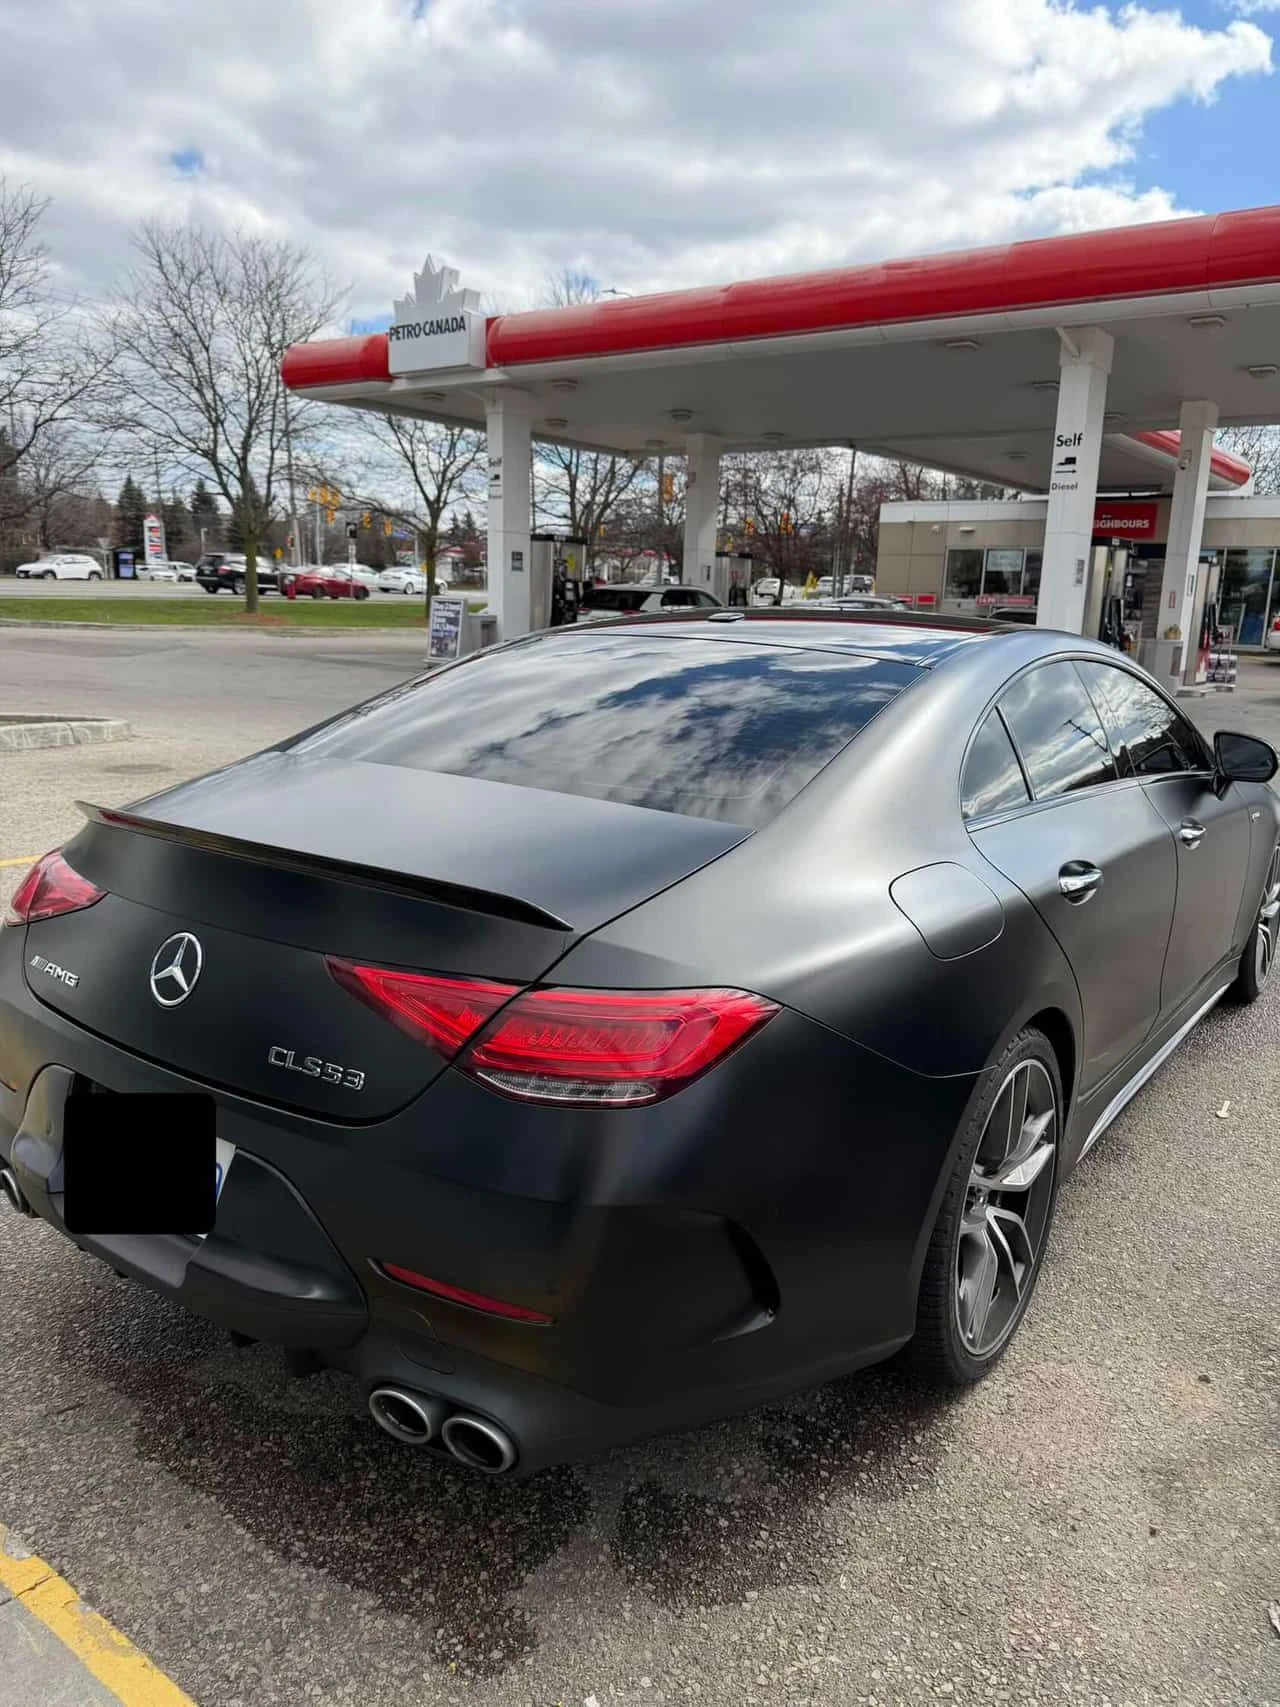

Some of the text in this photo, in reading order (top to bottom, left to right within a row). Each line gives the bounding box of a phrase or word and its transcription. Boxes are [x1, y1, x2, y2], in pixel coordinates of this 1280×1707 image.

[389, 316, 466, 342] PETRO CANADA
[1056, 432, 1083, 448] Self
[1051, 482, 1079, 491] Diesel
[1094, 519, 1150, 529] IGHBOURS
[44, 962, 80, 988] AMG
[267, 1046, 366, 1091] CLS53
